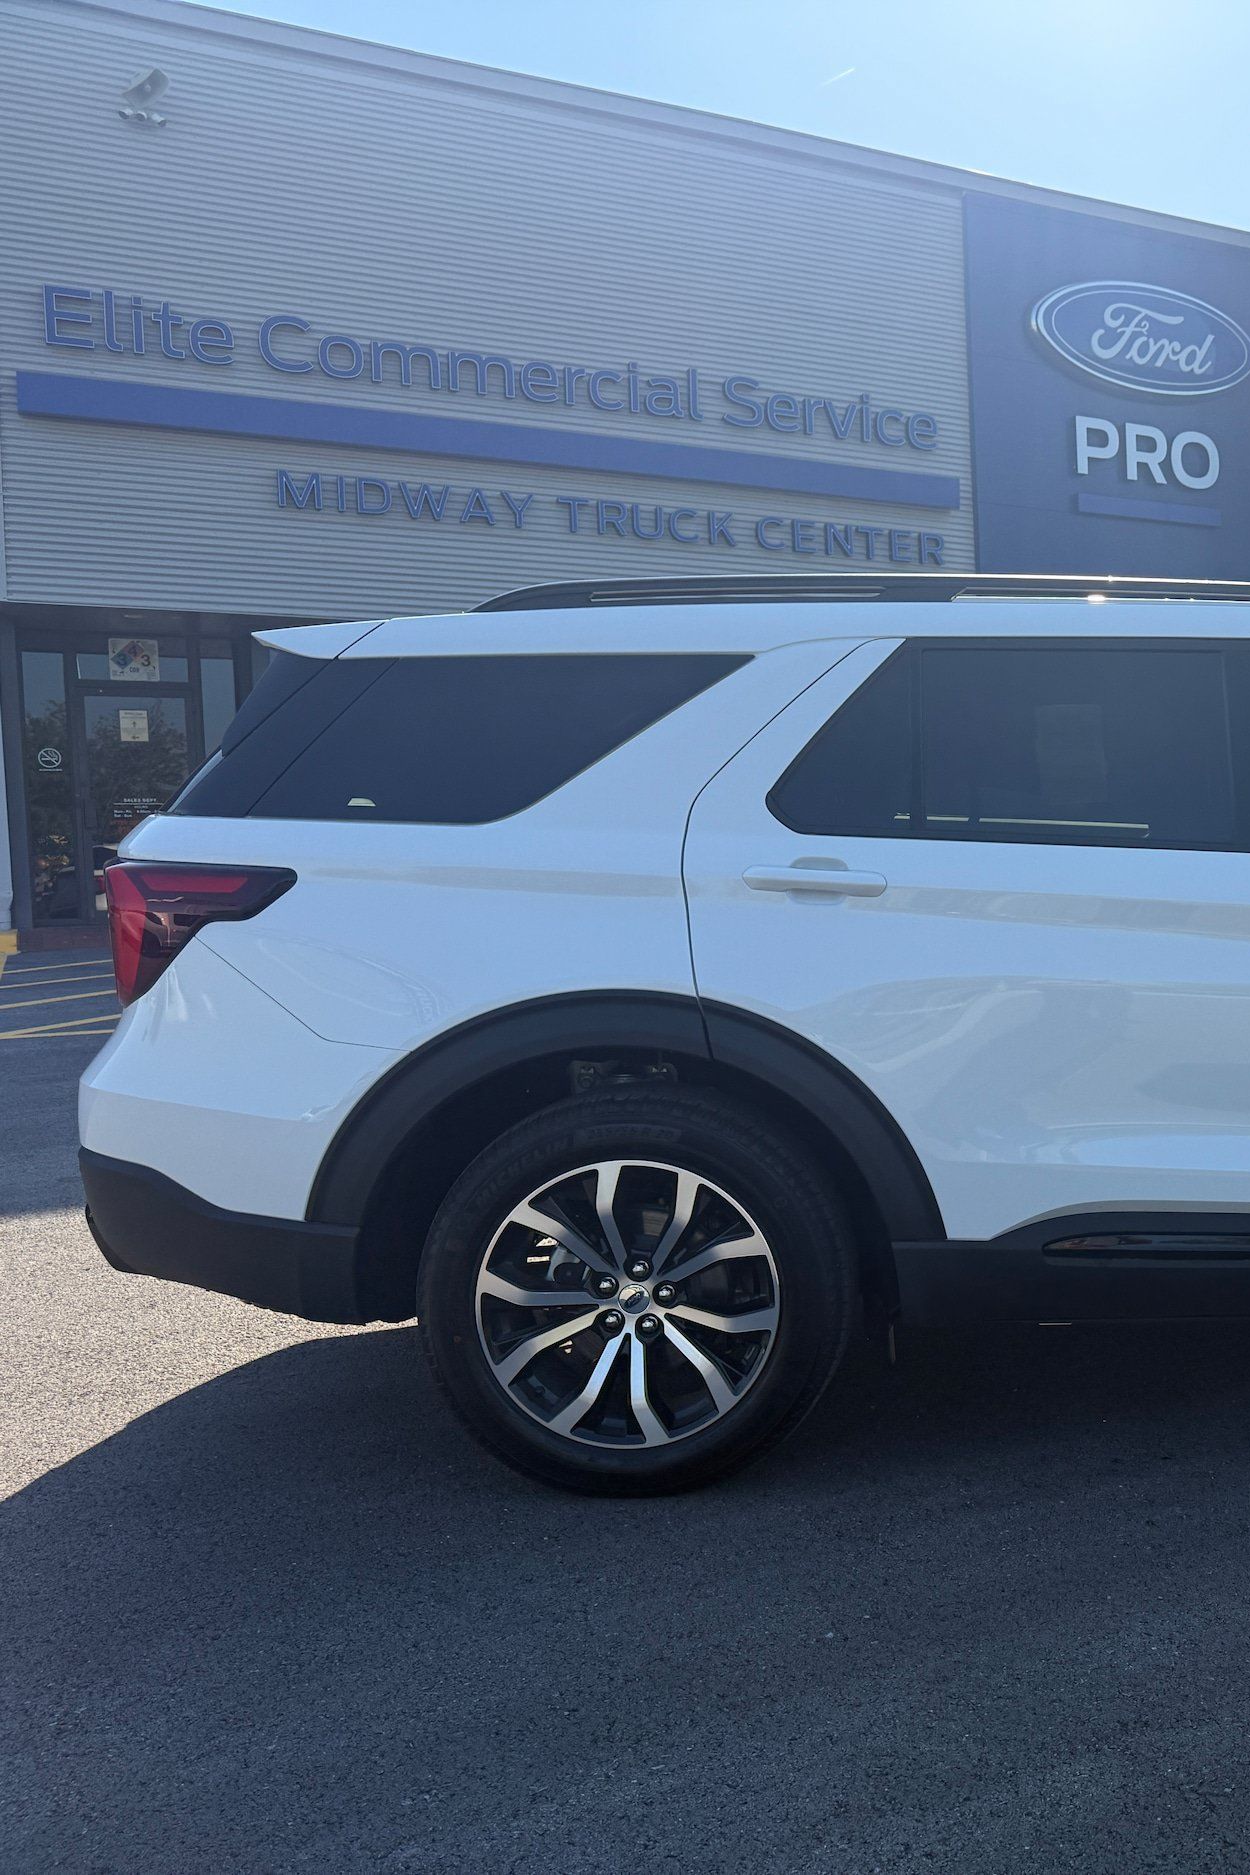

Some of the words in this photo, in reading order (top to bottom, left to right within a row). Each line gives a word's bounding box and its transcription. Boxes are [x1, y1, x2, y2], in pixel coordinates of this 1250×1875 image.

[42, 283, 235, 365] Elite
[258, 314, 704, 421] Commercial
[722, 375, 939, 450] Service
[1090, 302, 1215, 375] Ford
[1075, 415, 1220, 490] PRO
[276, 468, 533, 528] MIDWAY
[558, 497, 737, 547] TRUCK
[756, 516, 946, 566] CENTER
[141, 654, 151, 667] 3
